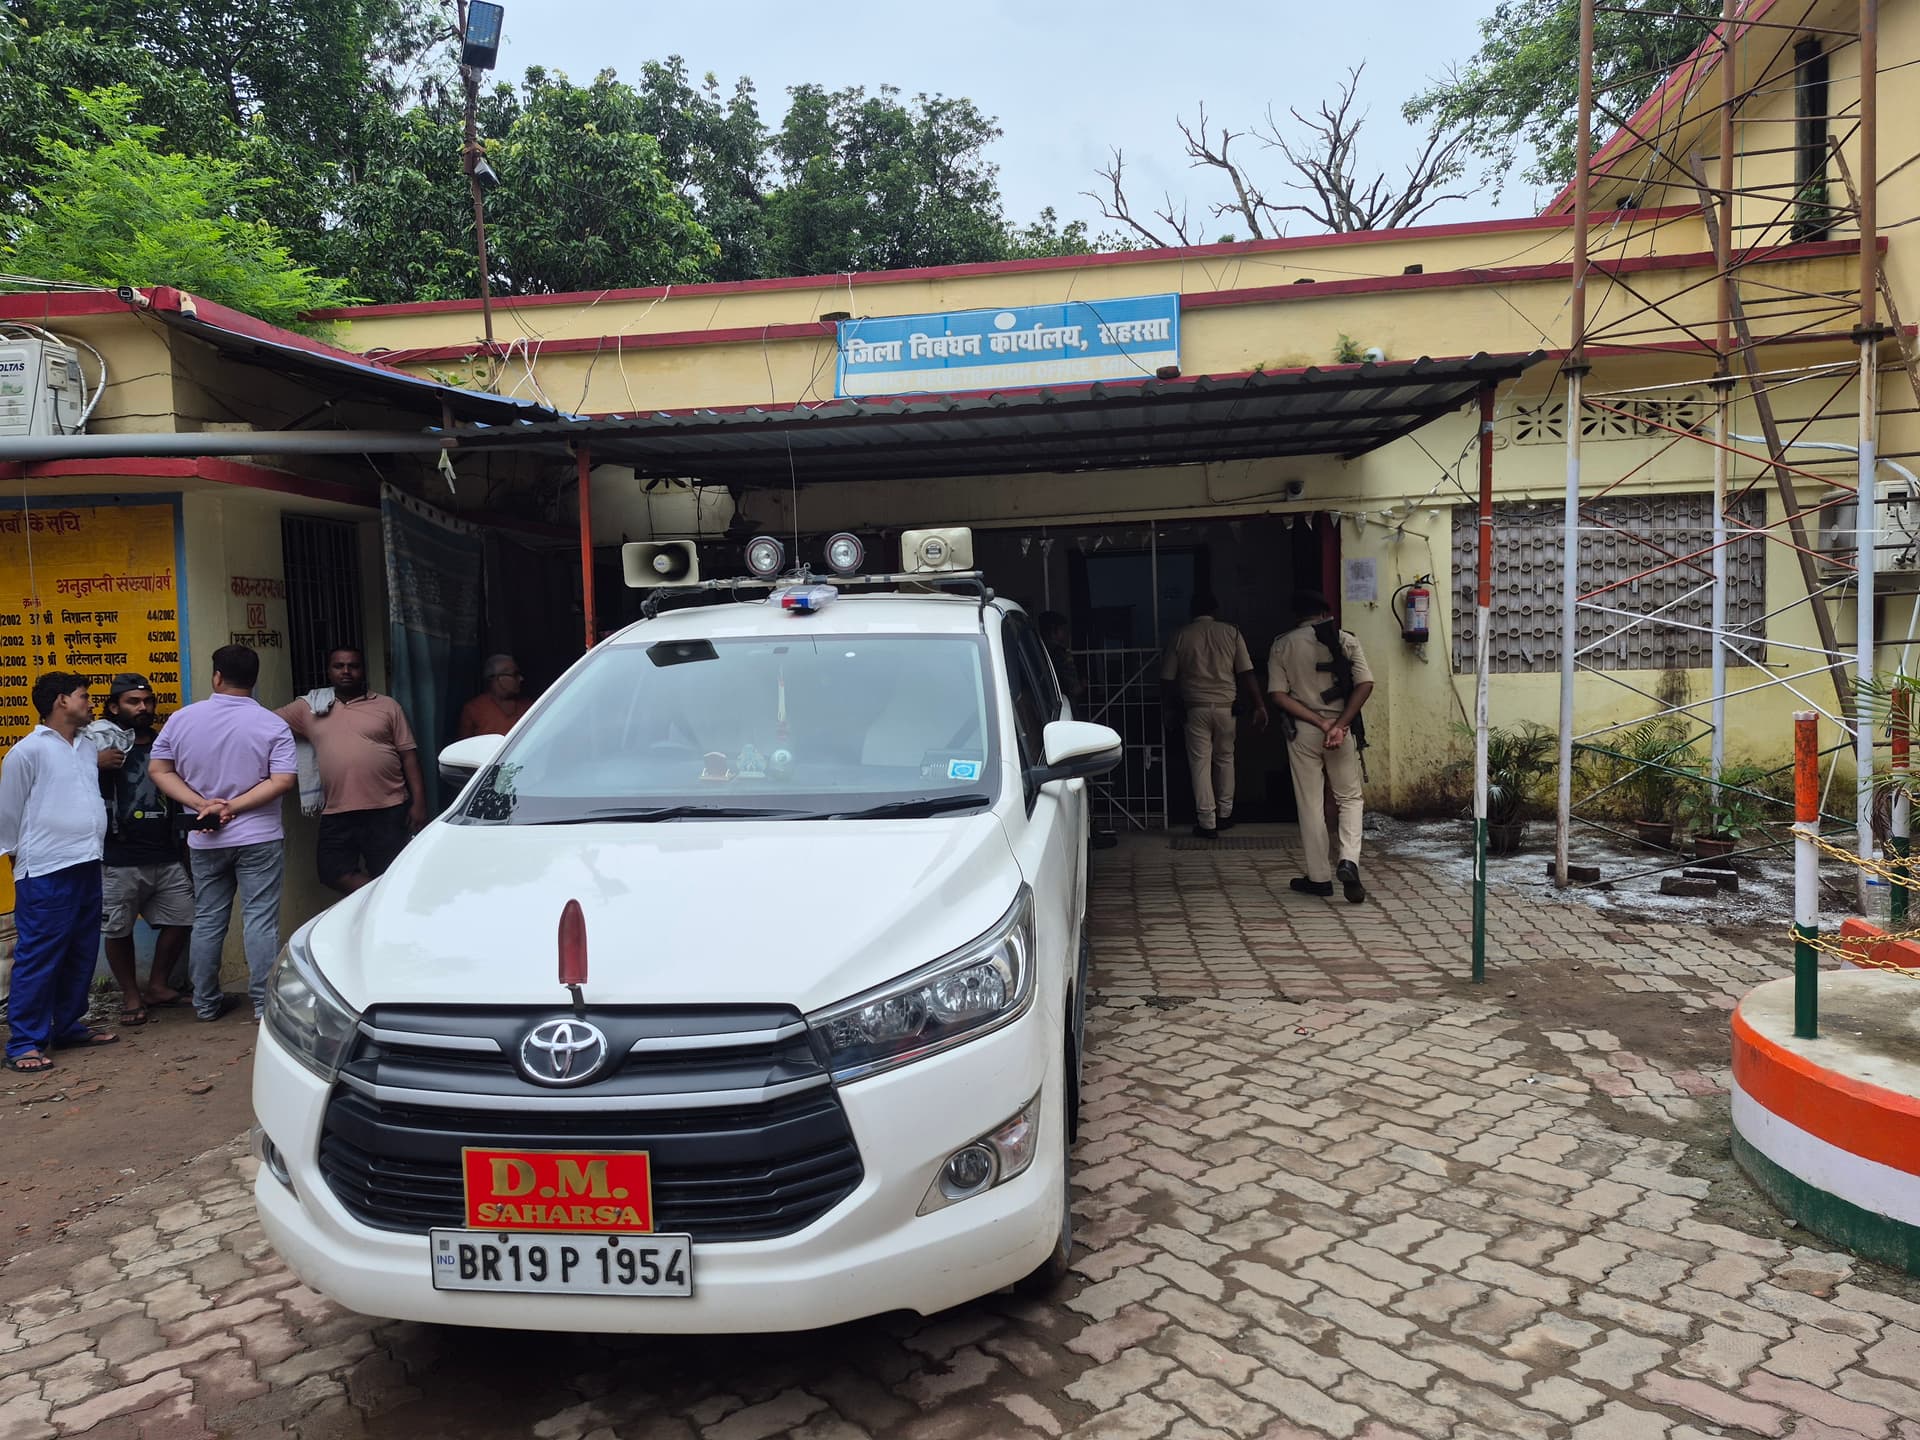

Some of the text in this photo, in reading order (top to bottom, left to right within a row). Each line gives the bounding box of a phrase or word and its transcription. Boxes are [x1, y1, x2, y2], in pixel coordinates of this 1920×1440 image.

[846, 317, 1171, 364] जिला निबंधन कार्यालय, सहरसा
[94, 610, 119, 627] कुमार
[92, 632, 118, 648] कुमार
[103, 653, 128, 666] यादव
[488, 1157, 629, 1199] D.M.
[477, 1202, 643, 1226] SAHARSA
[436, 1254, 456, 1266] IND
[458, 1243, 685, 1287] BR19 P 1954
